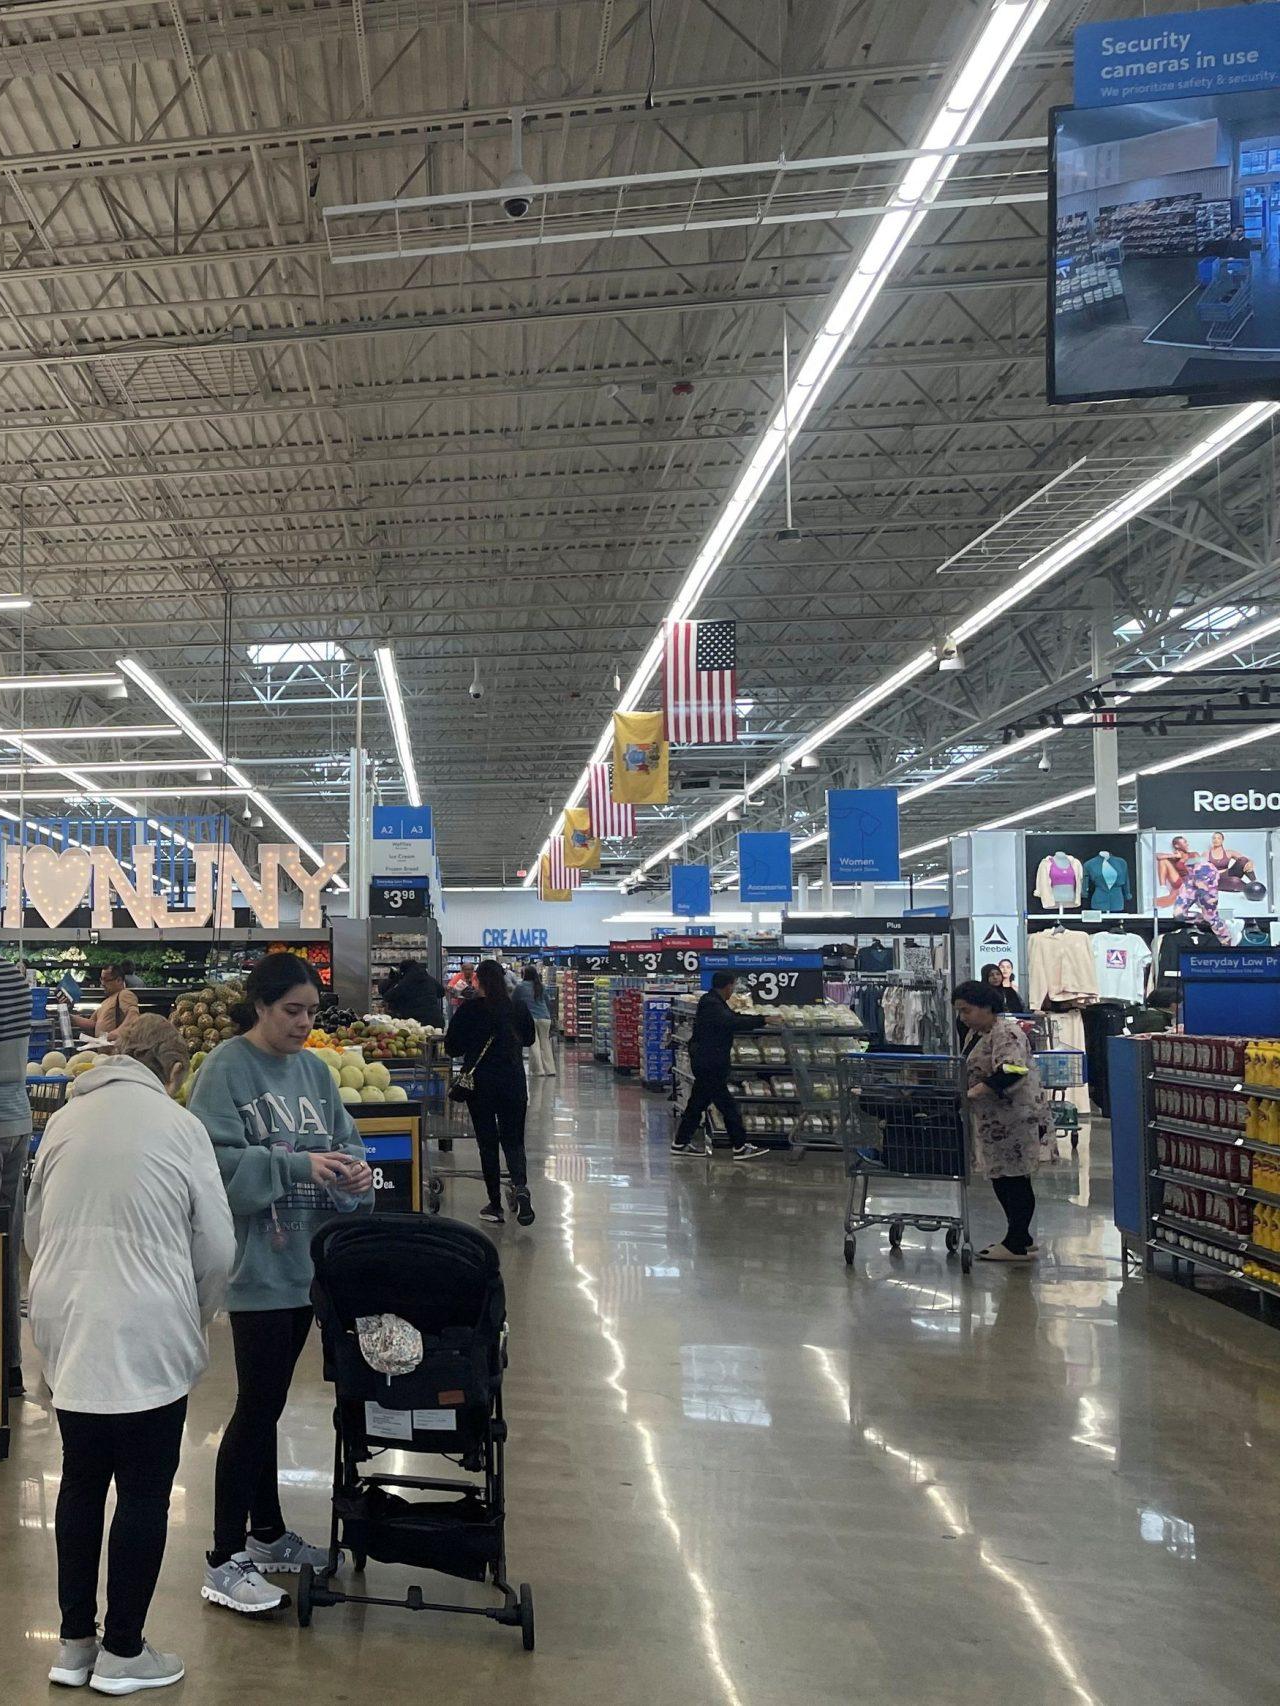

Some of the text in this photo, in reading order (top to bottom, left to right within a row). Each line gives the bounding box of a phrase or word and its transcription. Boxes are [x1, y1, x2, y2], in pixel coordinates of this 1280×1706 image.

[1101, 31, 1191, 57] Security
[1100, 50, 1259, 79] cameras in use
[1100, 69, 1279, 98] We prioritize safety & security.
[1193, 789, 1280, 813] Reebo
[380, 825, 394, 834] A2
[410, 825, 424, 834] A3
[839, 858, 875, 867] Women
[383, 890, 416, 909] $398
[886, 921, 902, 930] Plus
[482, 928, 548, 947] CREAMER
[979, 945, 1012, 953] Reebok
[637, 953, 663, 971] $37
[676, 950, 699, 971] $6
[734, 955, 763, 964] Everyday
[1190, 956, 1278, 969] Everyday Low Pr
[747, 972, 800, 1001] $397
[649, 1002, 671, 1010] PEP
